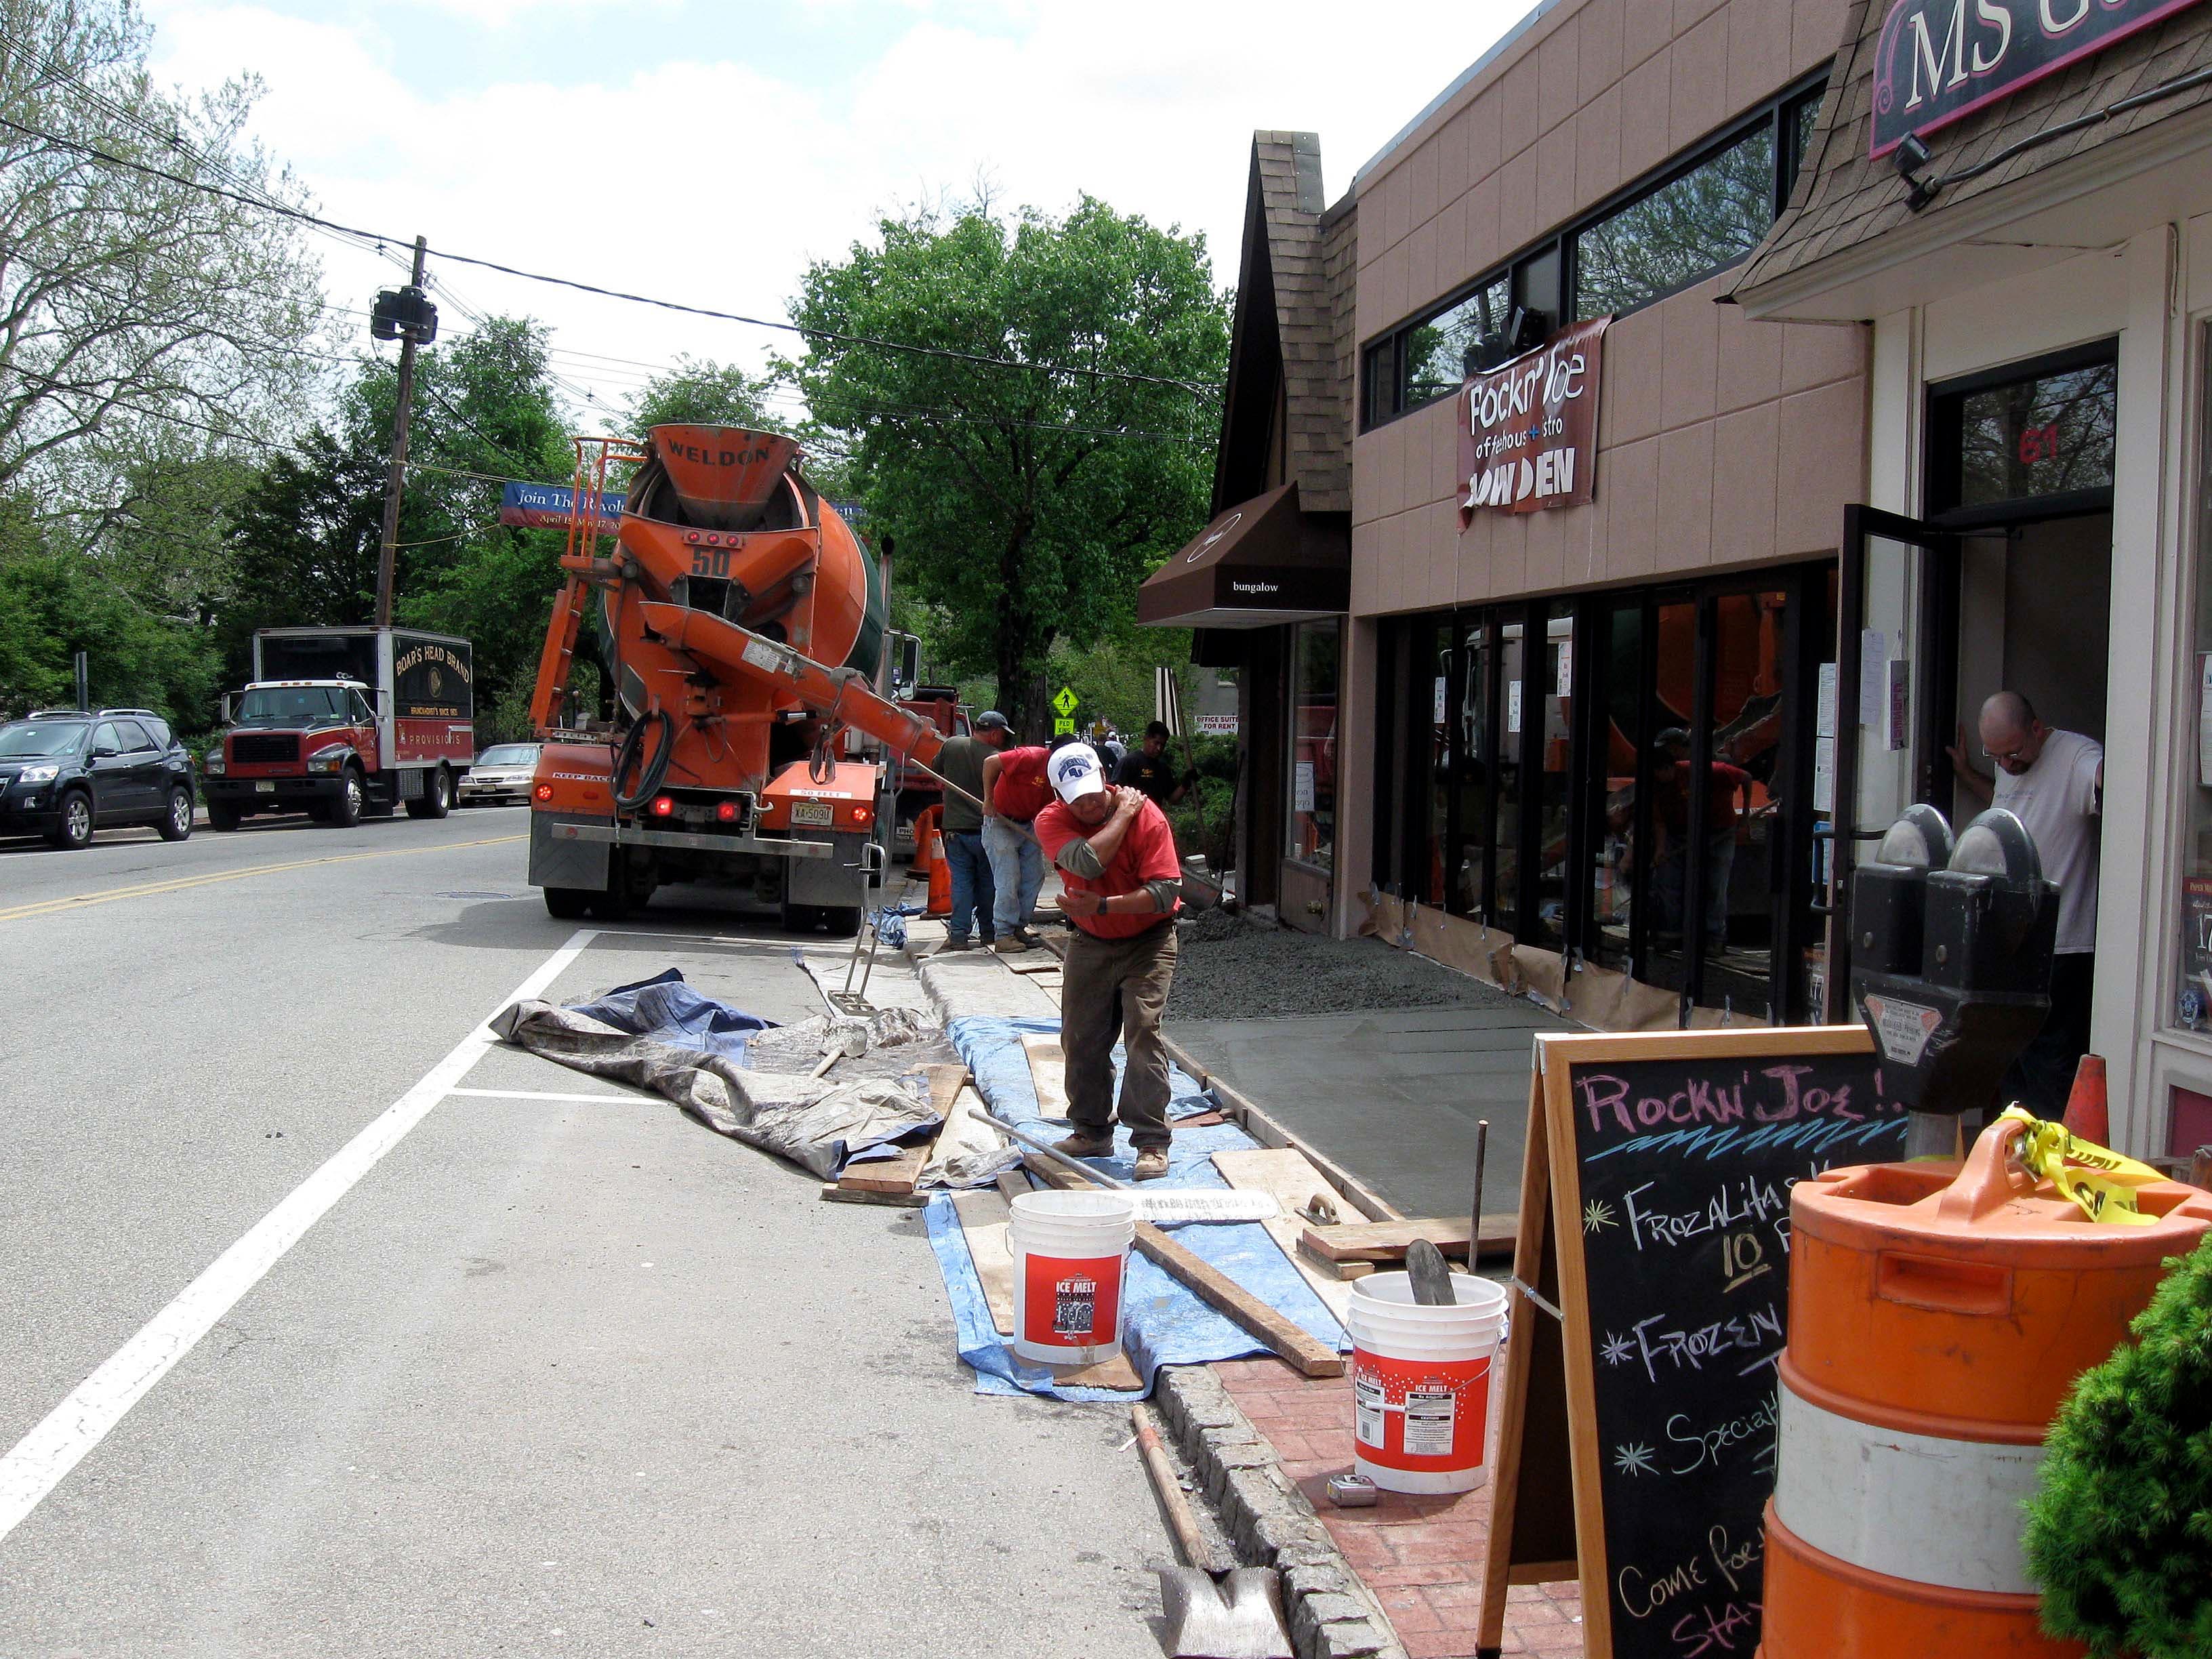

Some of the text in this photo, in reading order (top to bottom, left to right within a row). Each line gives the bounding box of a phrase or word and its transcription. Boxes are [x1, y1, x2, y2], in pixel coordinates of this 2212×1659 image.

[668, 438, 770, 467] WELDON
[2019, 424, 2058, 466] 61
[518, 489, 546, 506] Join
[539, 514, 561, 524] April
[691, 547, 731, 577] 50
[1233, 581, 1279, 594] bungalow
[396, 645, 470, 684] BOAR'S HEAD BRAND
[1723, 1233, 1762, 1277] 10
[1056, 1281, 1097, 1293] ICE MELT
[1415, 1385, 1448, 1393] ICE MELT
